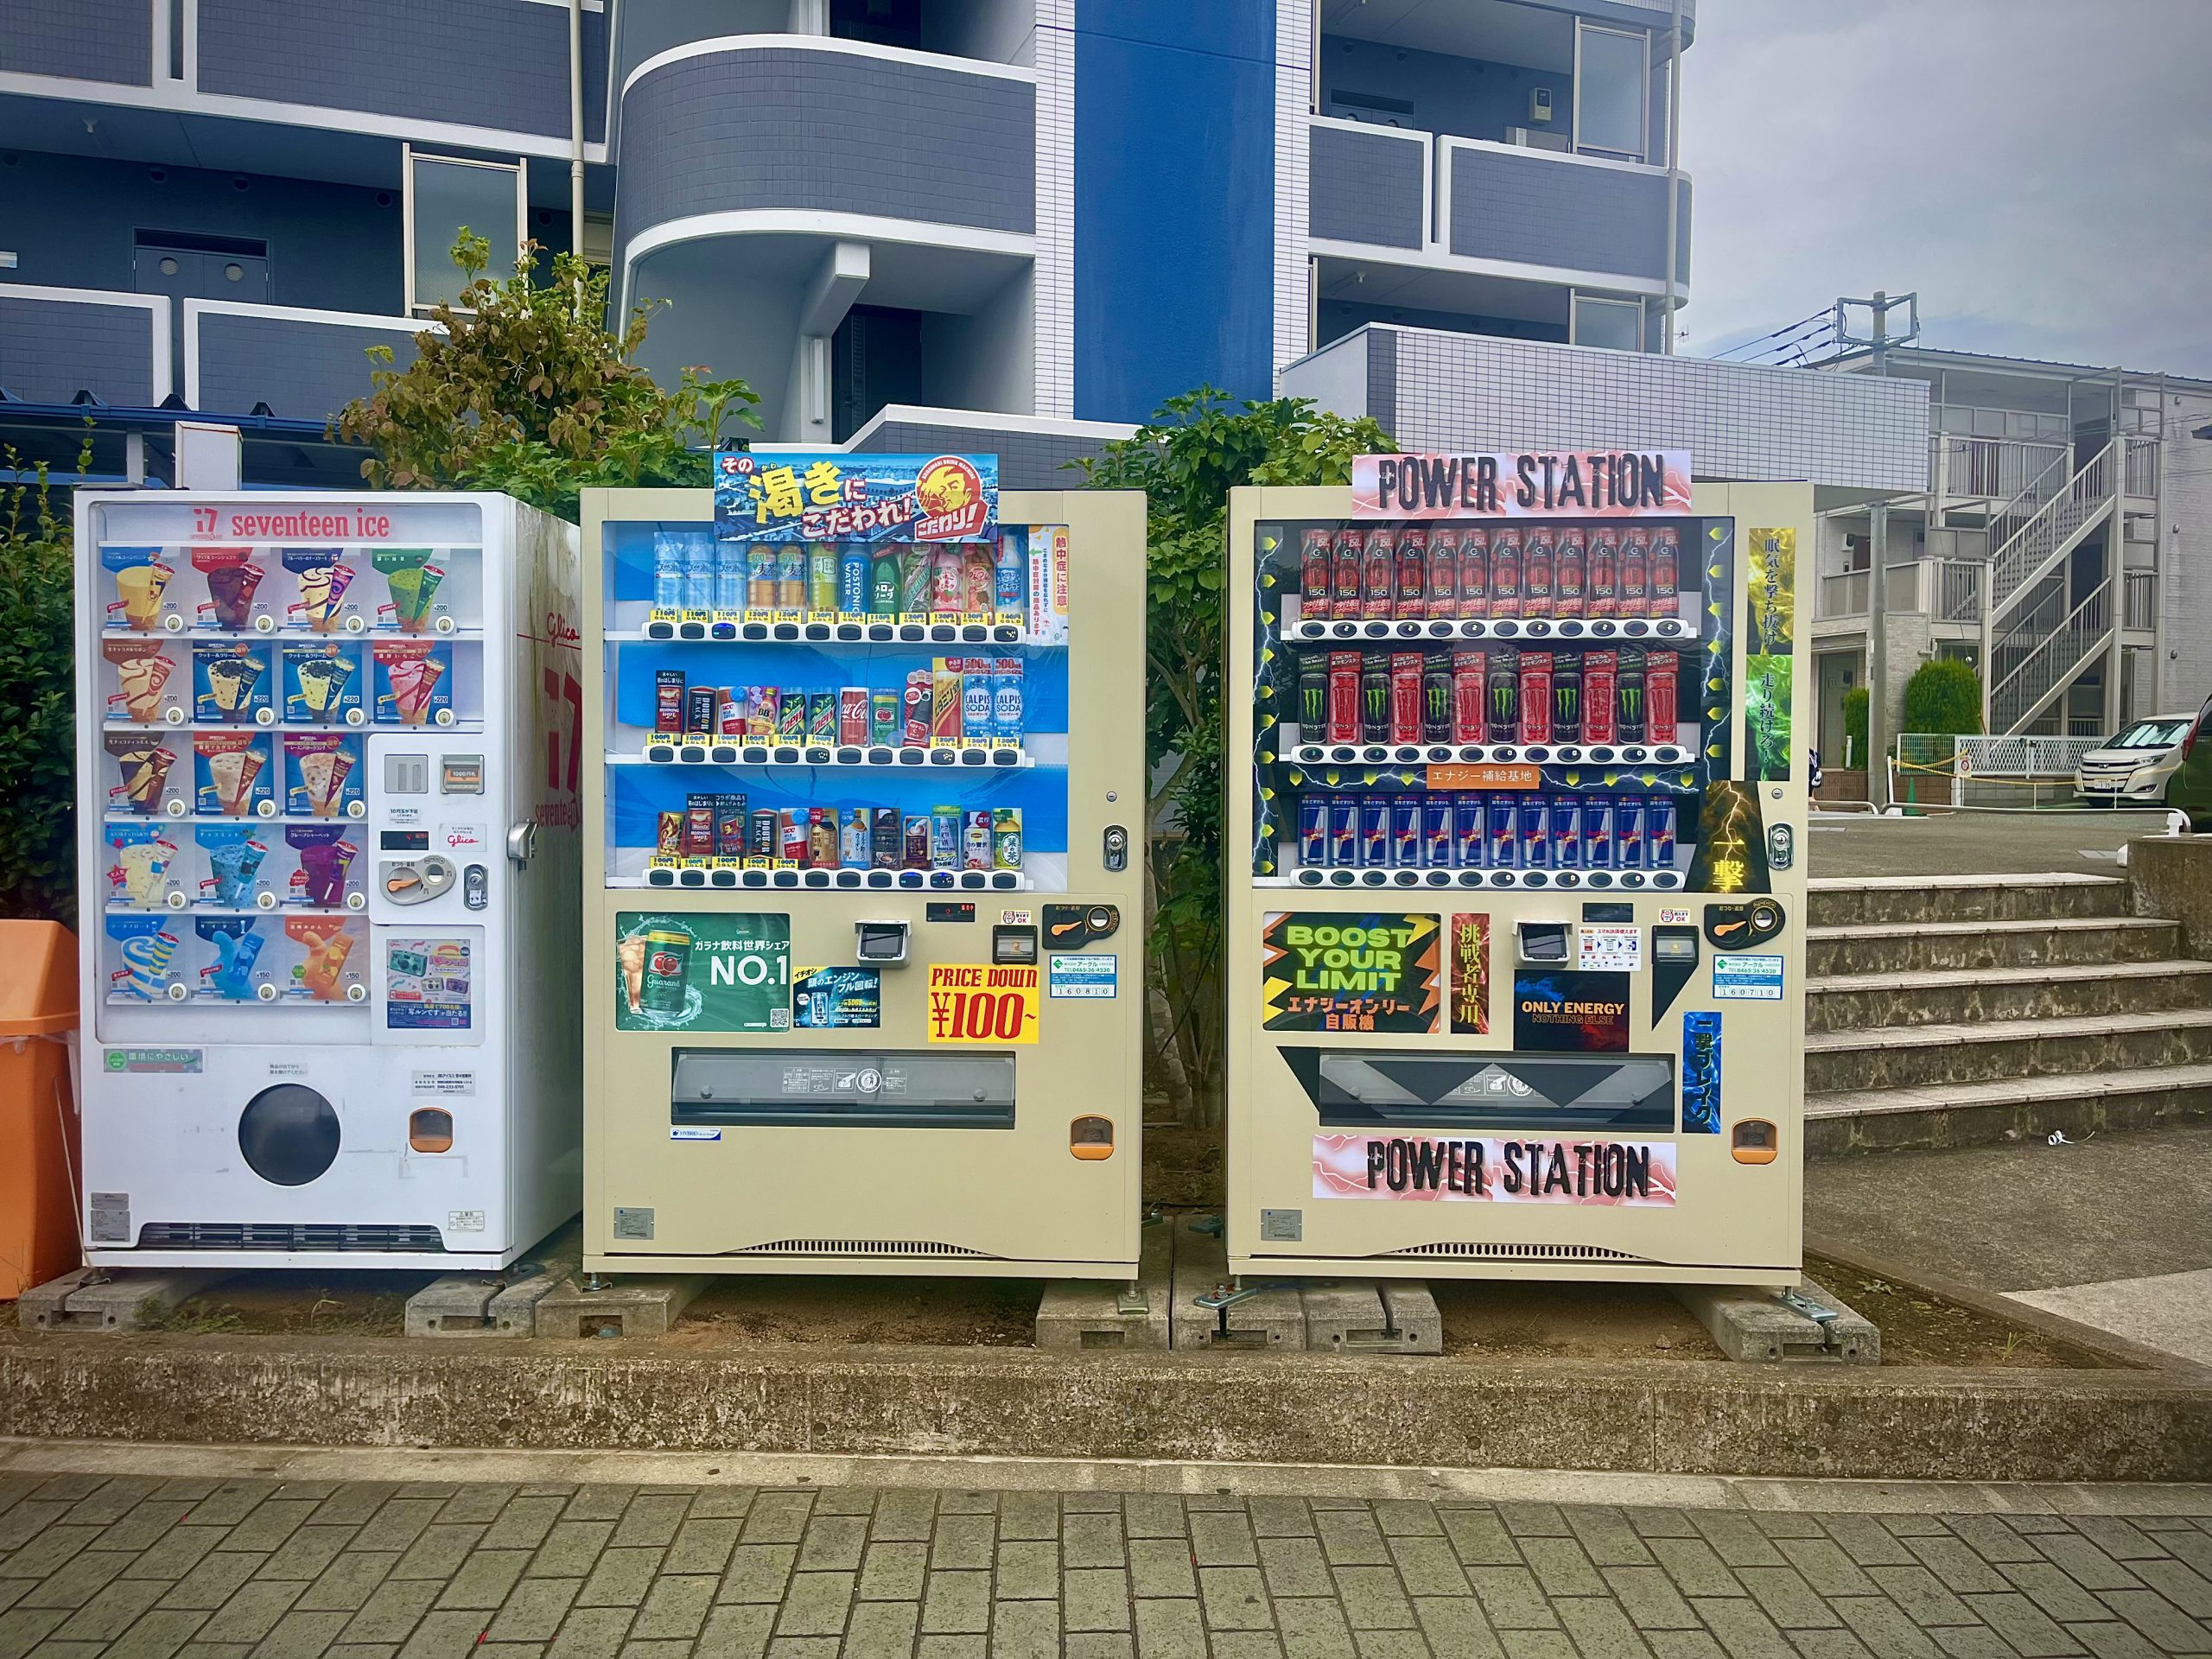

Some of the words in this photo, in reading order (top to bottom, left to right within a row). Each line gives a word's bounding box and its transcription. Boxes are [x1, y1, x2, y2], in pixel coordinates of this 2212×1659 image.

[721, 456, 753, 474] その
[1378, 456, 1497, 512] POWER
[1516, 454, 1663, 509] STATION
[232, 510, 349, 537] seventeen
[357, 507, 389, 537] ice
[802, 496, 912, 537] こだわれ!
[1056, 537, 1067, 606] 熱中症に注意
[1763, 538, 1780, 645] 眠気を撃ち抜け
[546, 612, 580, 647] Glico
[965, 694, 990, 704] CALPIS
[995, 694, 1020, 704] CALPIS
[758, 708, 770, 717] BB
[1759, 672, 1776, 764] 走り続けろ!
[1432, 769, 1533, 782] エナジー補給基地
[448, 835, 479, 847] Glico
[1713, 839, 1745, 889] 一撃
[694, 940, 790, 951] ガラナ飲料世界シェア
[1287, 925, 1414, 949] BOOST
[1296, 948, 1402, 969] YOUR
[710, 955, 787, 986] NO.1
[794, 968, 817, 979] イチオシ
[807, 972, 860, 988] 頭のエンジン
[931, 968, 982, 988] PRICE
[987, 969, 1038, 988] DOWN
[1296, 969, 1402, 992] LIMIT
[1460, 923, 1481, 1025] 挑戦者専用
[837, 977, 879, 994] フル回転!
[1287, 996, 1411, 1015] エナジーオンリー
[1522, 1001, 1561, 1014] ONLY
[1564, 1002, 1624, 1016] ENERGY
[1325, 1014, 1375, 1031] 自販機
[1532, 1013, 1583, 1024] NOTHING
[1585, 1014, 1613, 1026] ELSE
[1366, 1139, 1484, 1197] POWER
[1503, 1141, 1649, 1198] STATION
